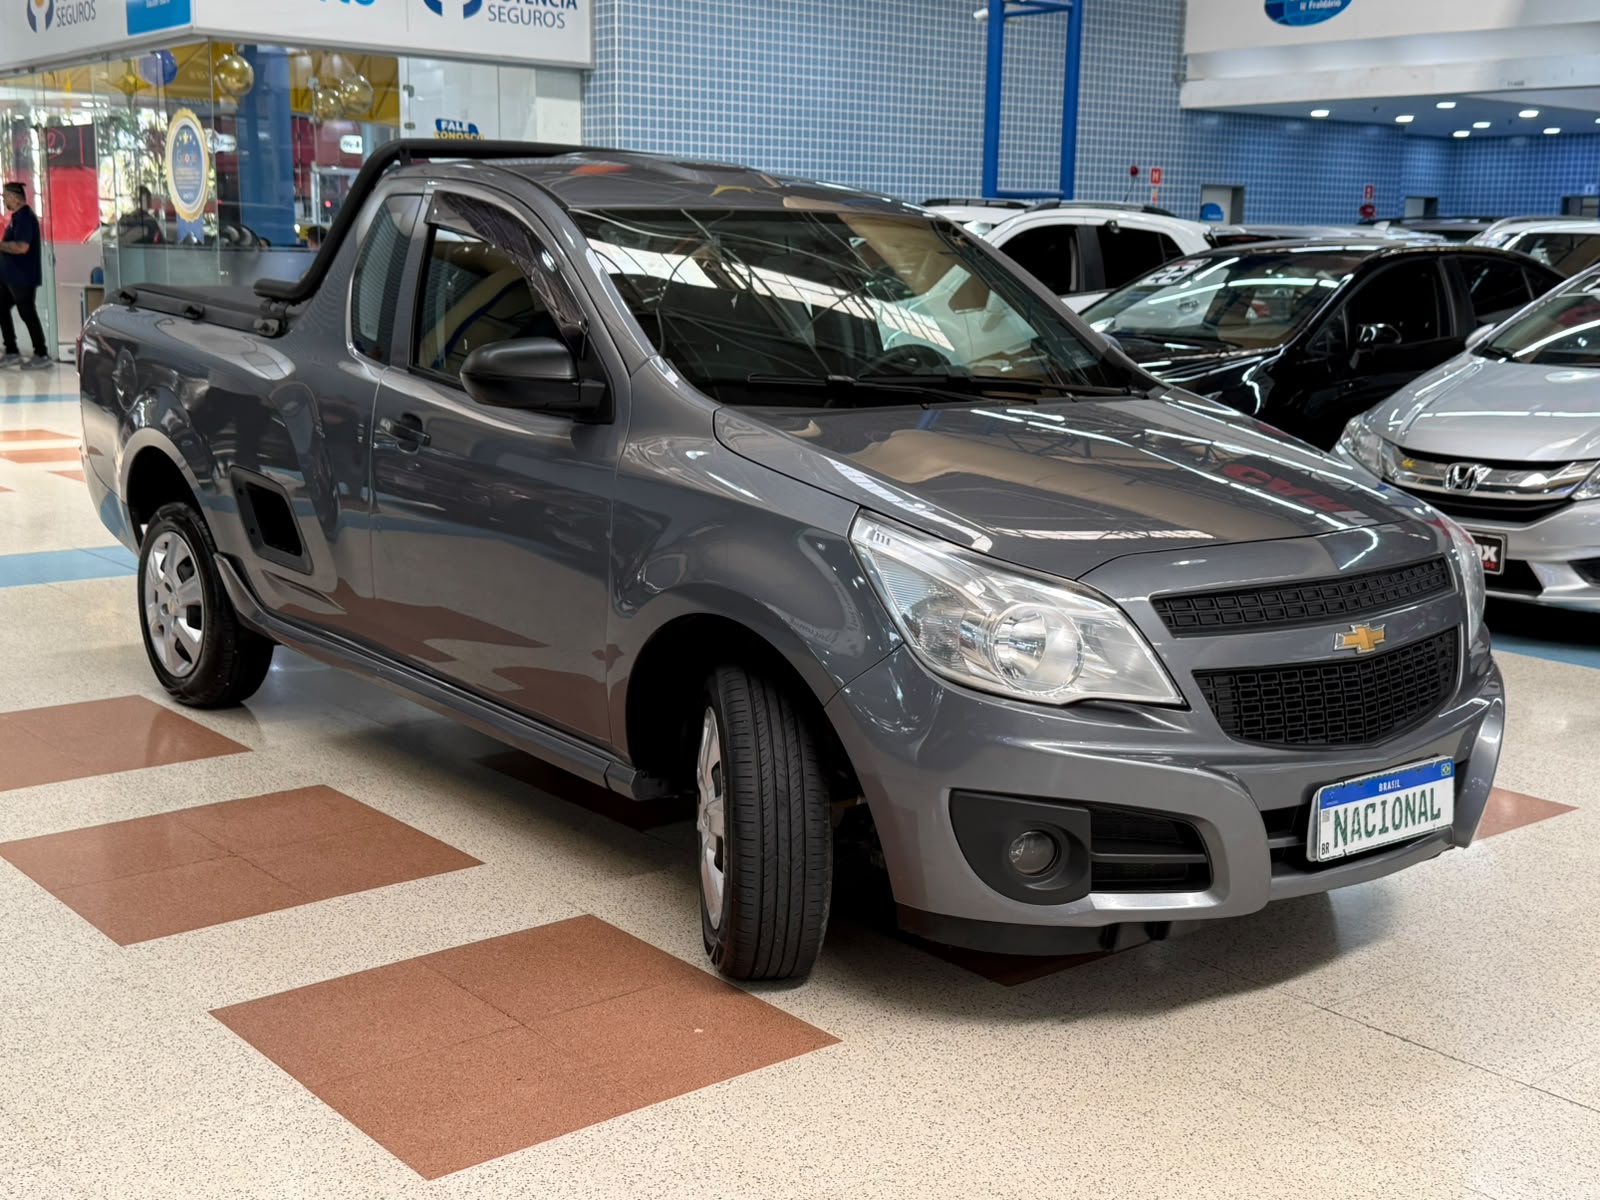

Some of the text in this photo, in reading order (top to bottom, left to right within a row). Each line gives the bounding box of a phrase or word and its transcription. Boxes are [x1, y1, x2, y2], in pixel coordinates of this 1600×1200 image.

[56, 2, 96, 27] SEGUROS
[488, 5, 566, 29] SEGUROS
[1378, 779, 1401, 792] BRASIL
[1333, 787, 1441, 849] NACIONAL
[1321, 841, 1330, 856] BR
